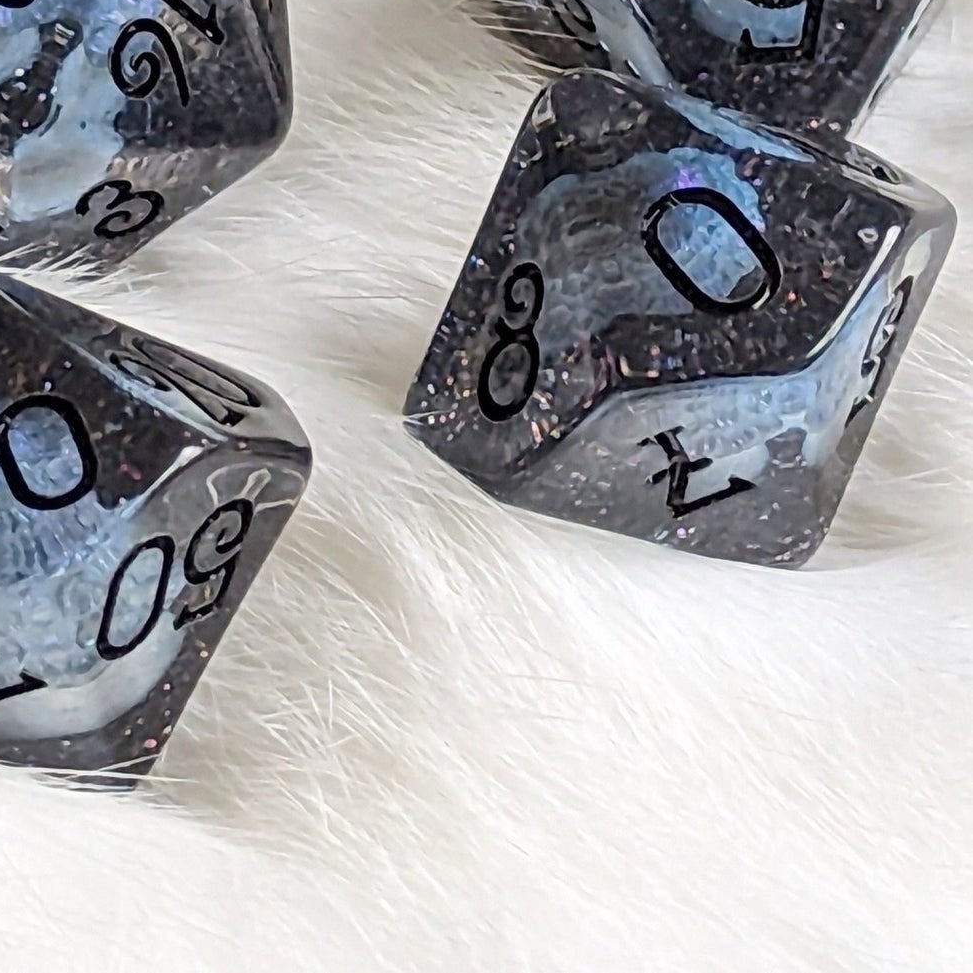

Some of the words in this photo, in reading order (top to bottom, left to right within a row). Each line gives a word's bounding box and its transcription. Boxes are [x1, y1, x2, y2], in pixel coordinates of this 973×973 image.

[76, 179, 165, 238] 3
[641, 188, 782, 313] 0
[477, 262, 545, 422] 8
